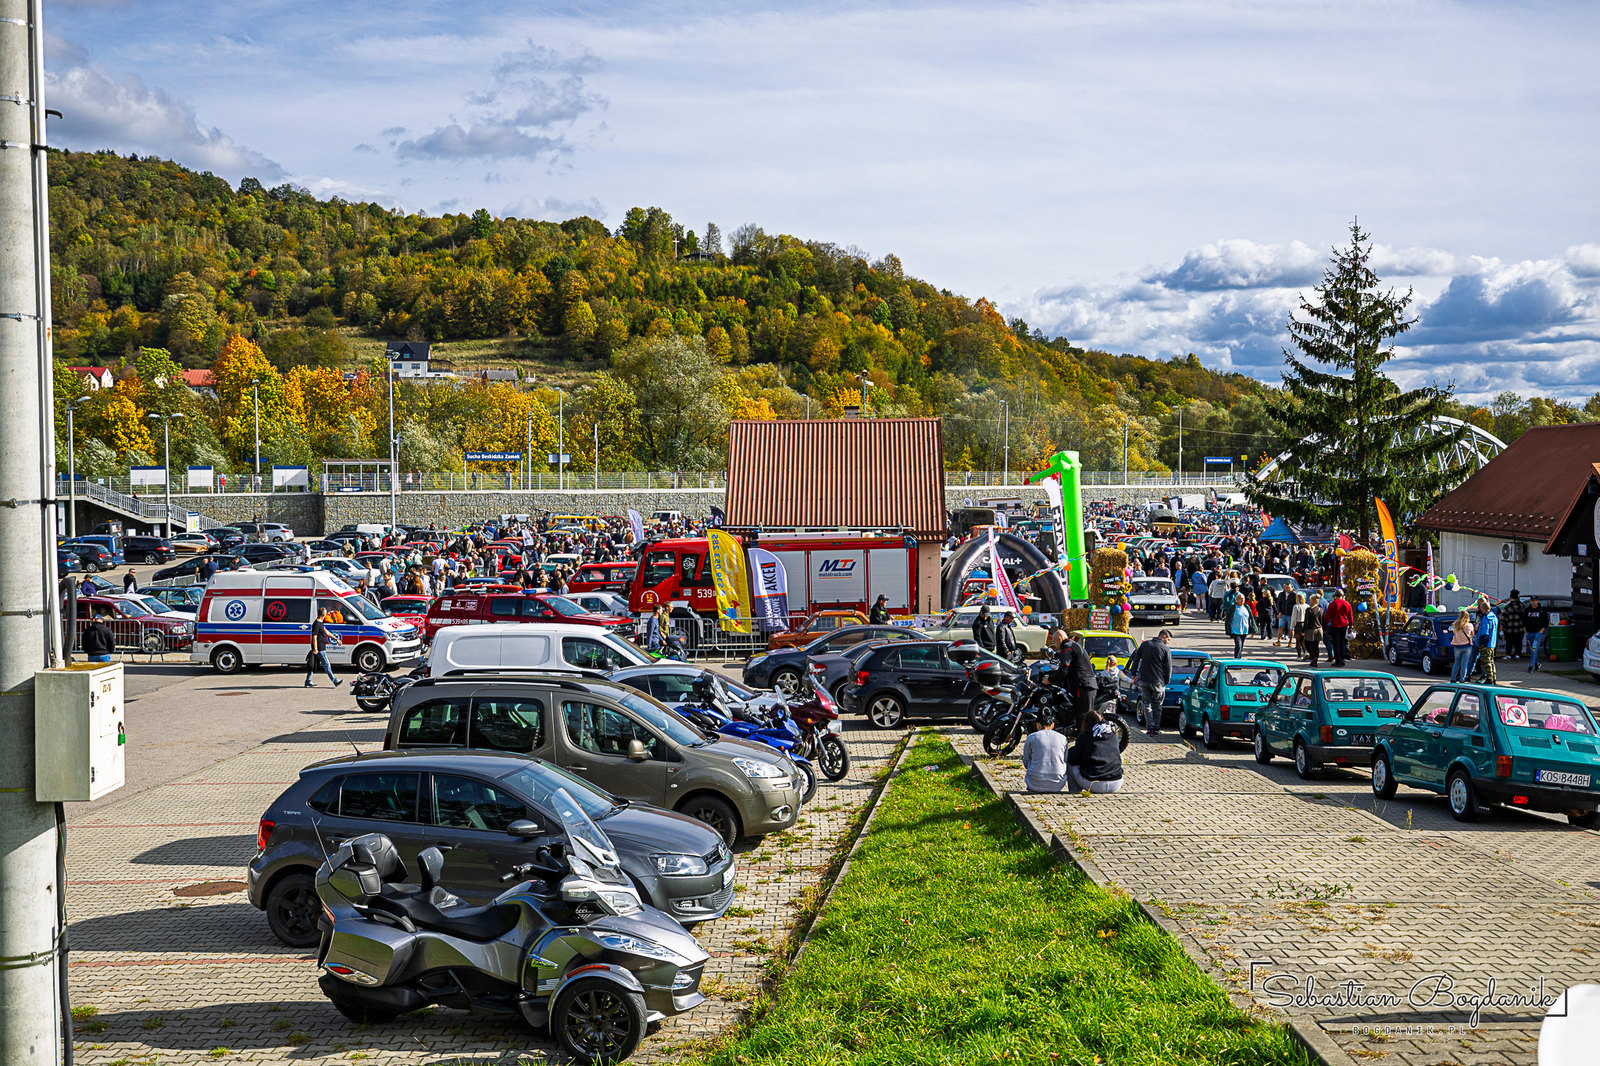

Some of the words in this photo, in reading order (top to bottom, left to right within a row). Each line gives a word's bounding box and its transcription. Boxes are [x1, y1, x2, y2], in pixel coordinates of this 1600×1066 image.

[760, 562, 778, 591] AKCES
[1540, 770, 1558, 782] KOS
[1560, 773, 1590, 786] 8448H
